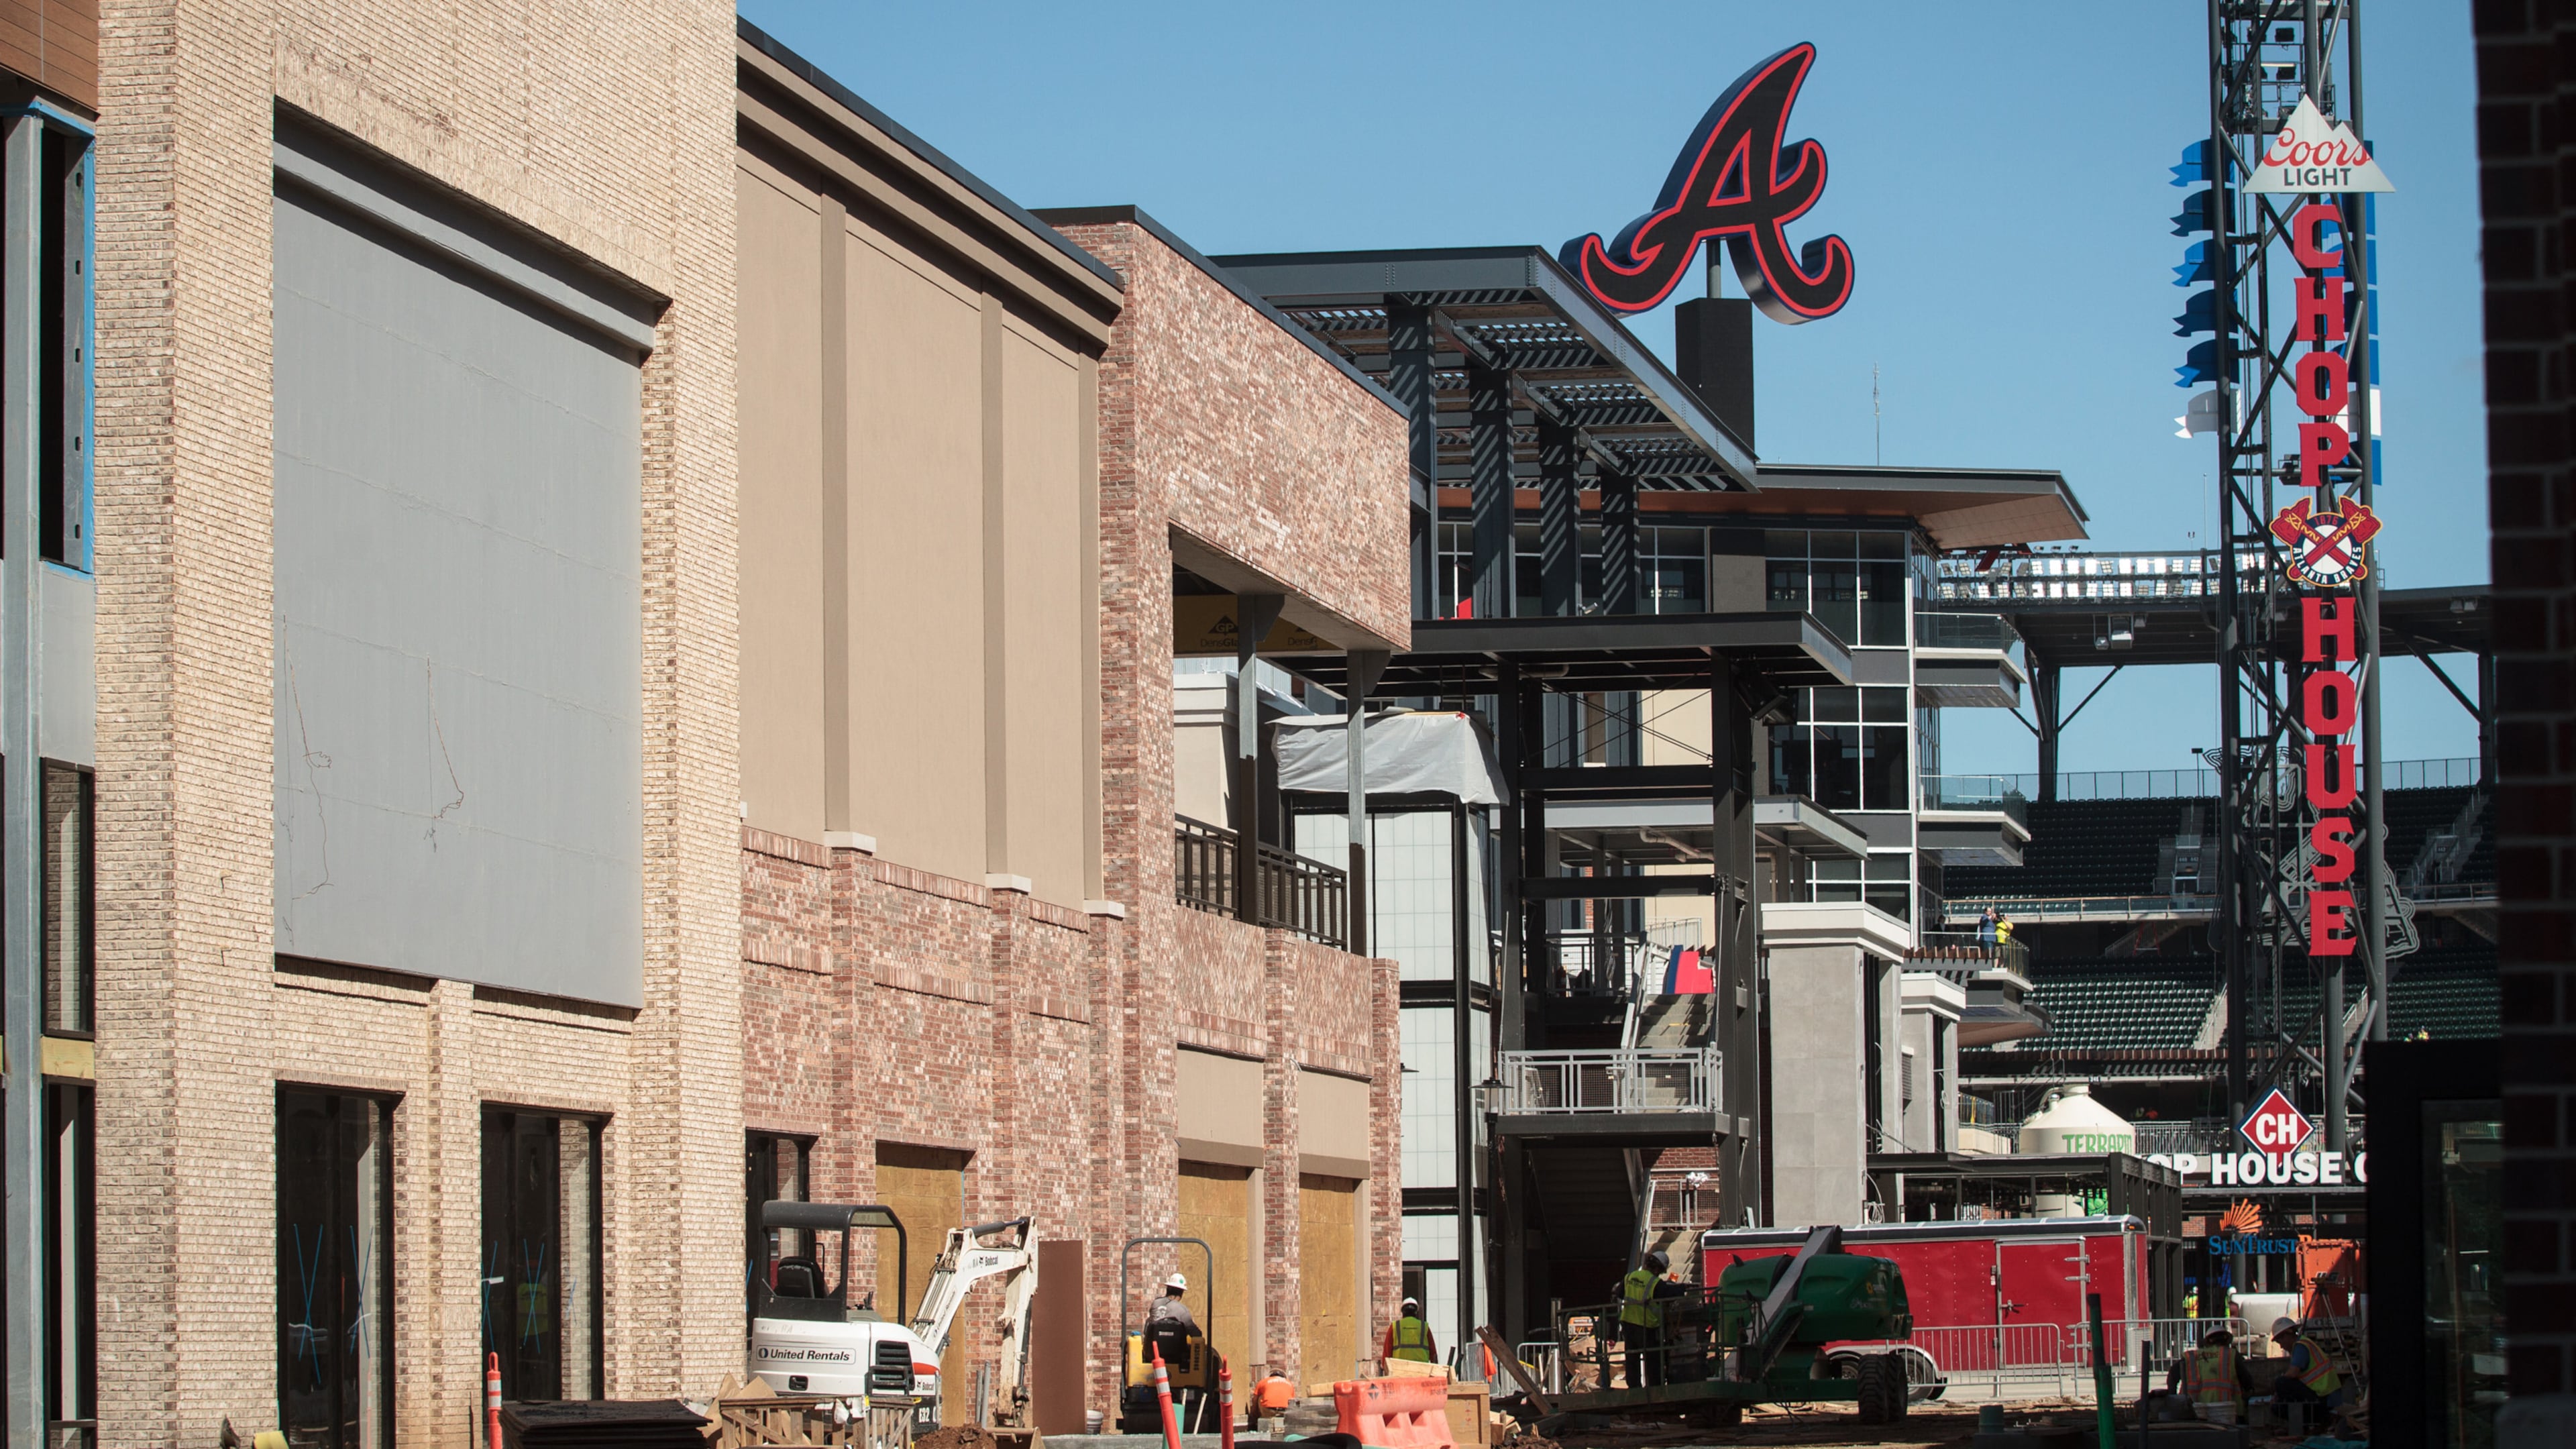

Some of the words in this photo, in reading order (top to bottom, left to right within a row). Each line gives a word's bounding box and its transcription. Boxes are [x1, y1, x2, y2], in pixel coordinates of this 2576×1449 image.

[2263, 127, 2370, 167] Coors
[2284, 168, 2351, 186] LIGHT
[2293, 204, 2350, 487] CHOP
[2293, 547, 2328, 584] ATLANTA
[2333, 546, 2362, 583] BRAVES
[1216, 623, 1235, 633] GP
[2301, 597, 2357, 956] HOUSE
[2255, 1113, 2298, 1145] CH
[2211, 1151, 2343, 1185] HOUSE
[771, 1348, 803, 1360] United
[806, 1350, 850, 1361] Rentals
[918, 1407, 930, 1424] E32
